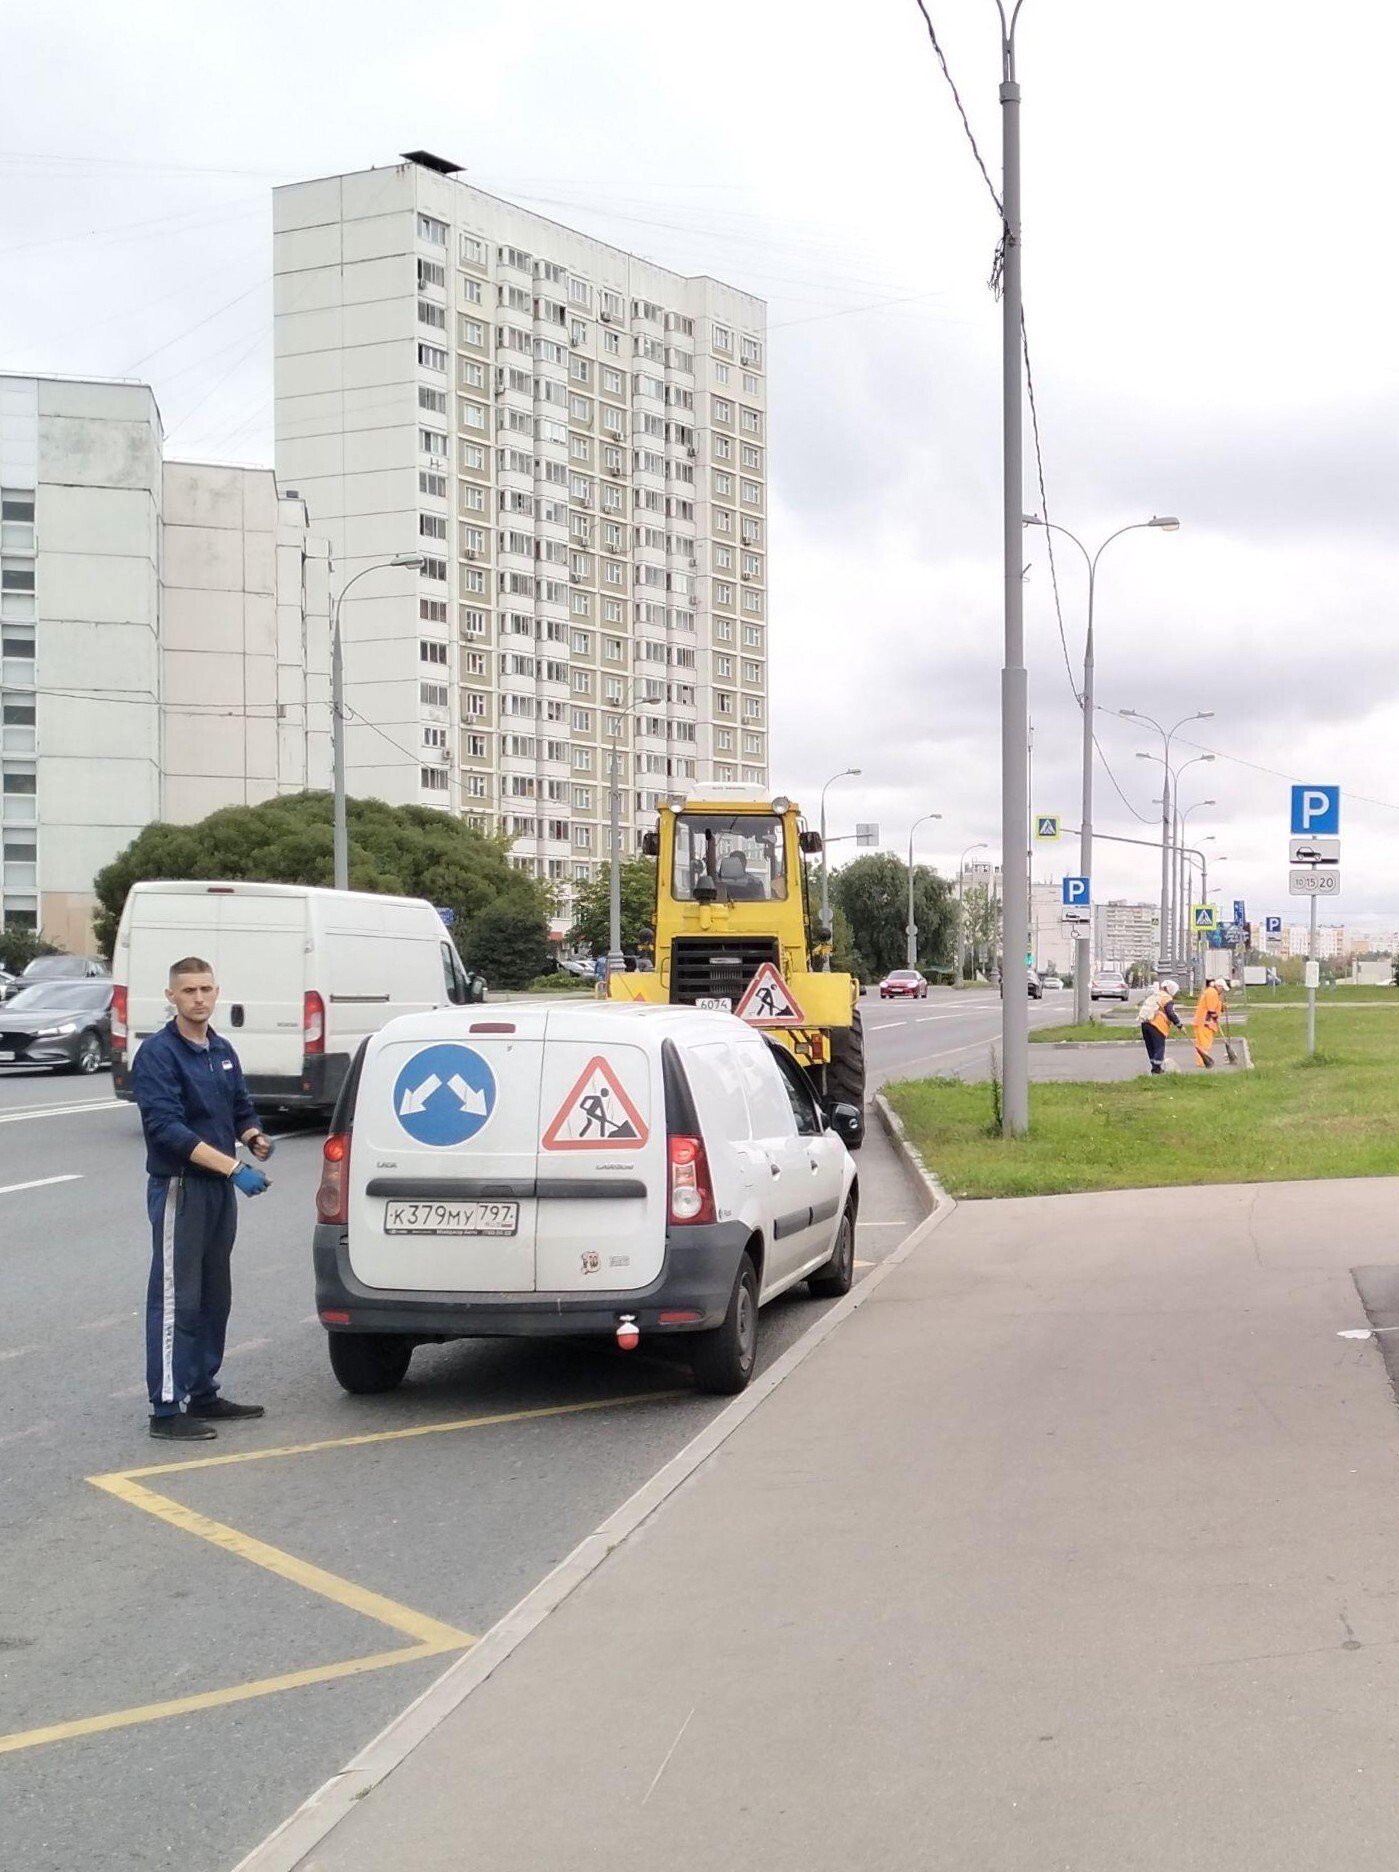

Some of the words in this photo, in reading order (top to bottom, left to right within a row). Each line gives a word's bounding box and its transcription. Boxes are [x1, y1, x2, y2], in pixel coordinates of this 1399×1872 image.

[1303, 791, 1330, 829] P
[1069, 880, 1085, 902] P
[1306, 878, 1316, 887] 15
[1320, 878, 1334, 888] 20
